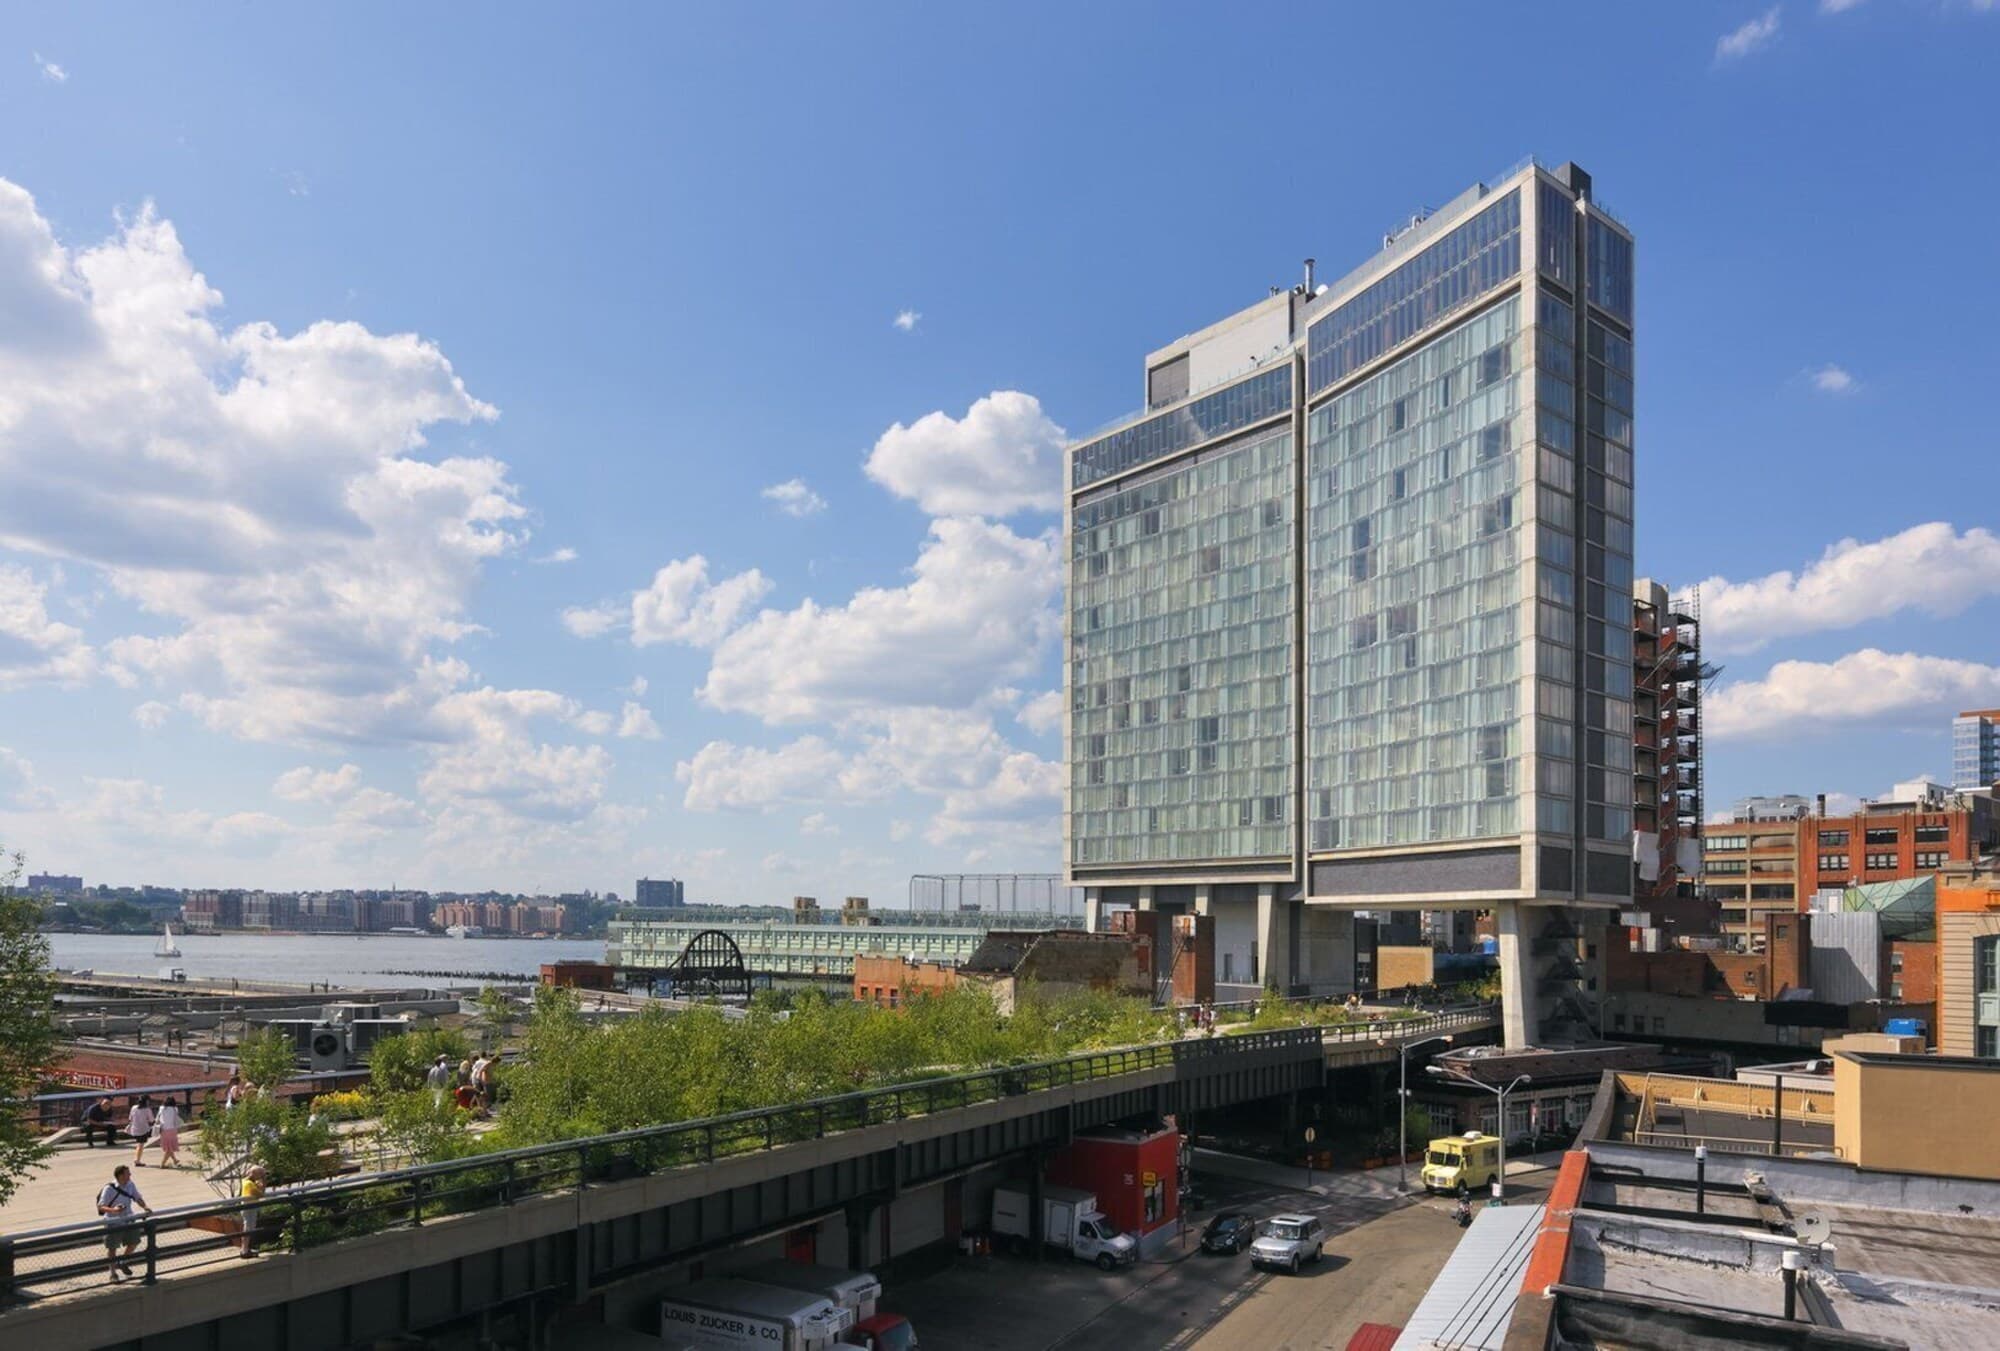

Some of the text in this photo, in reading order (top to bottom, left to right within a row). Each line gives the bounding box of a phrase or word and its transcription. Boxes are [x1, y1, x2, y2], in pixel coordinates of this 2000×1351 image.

[664, 1307, 696, 1324] LOUIS
[699, 1314, 744, 1334] ZUCKER
[748, 1325, 757, 1337] &
[760, 1327, 781, 1341] CO.
